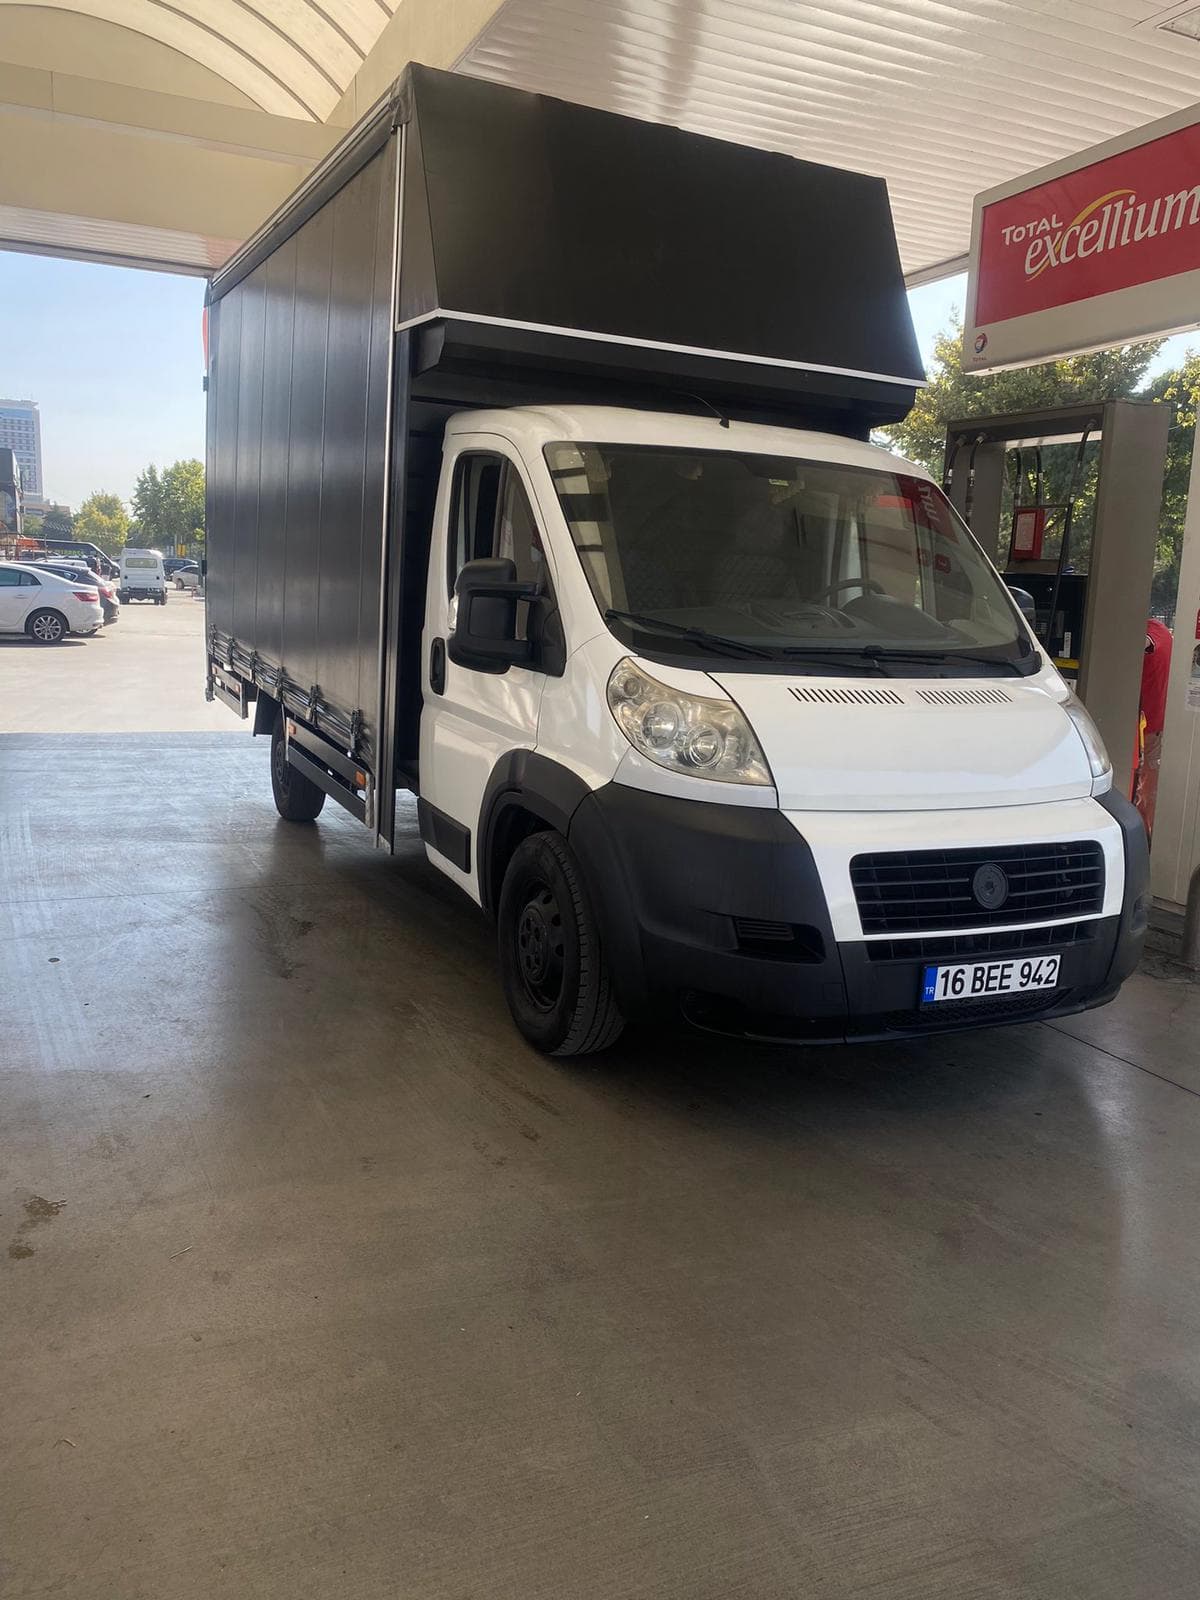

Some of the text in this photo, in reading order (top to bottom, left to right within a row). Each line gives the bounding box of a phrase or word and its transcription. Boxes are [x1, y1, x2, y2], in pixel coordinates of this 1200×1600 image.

[1001, 214, 1063, 246] TOTAL
[1024, 185, 1200, 275] excellium
[925, 986, 935, 996] TR
[940, 958, 1058, 997] 16 BEE 942
